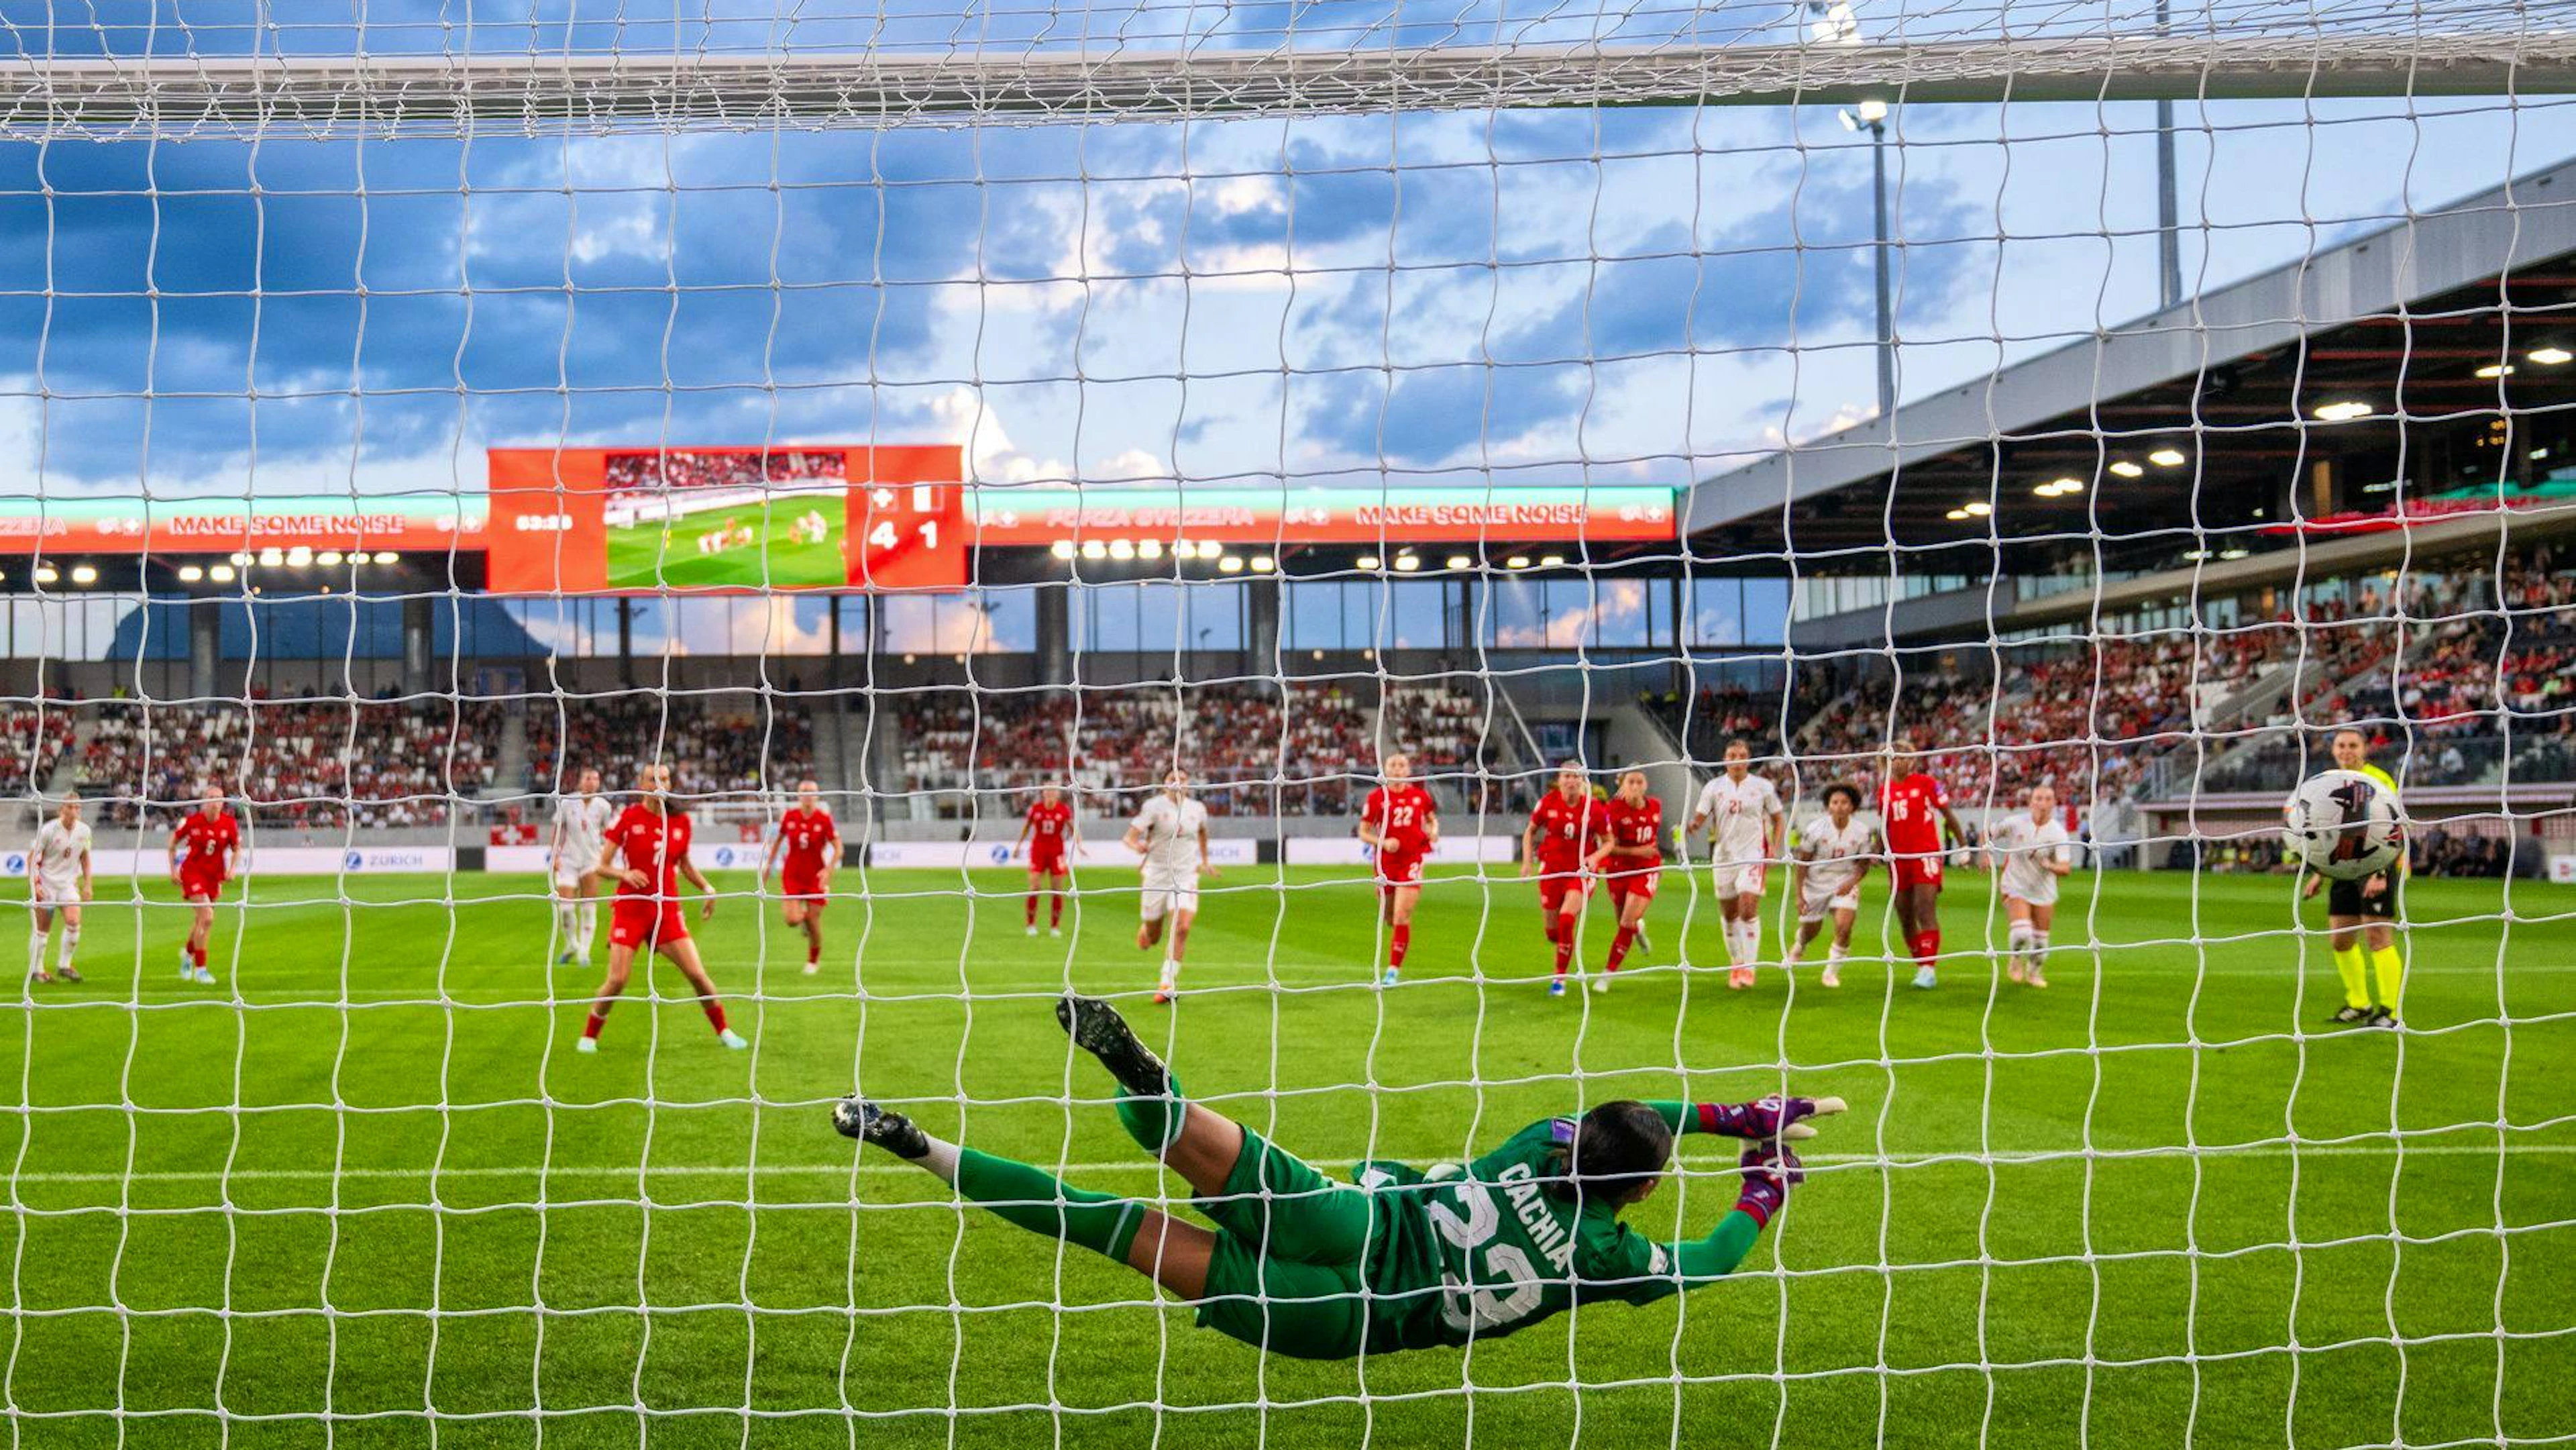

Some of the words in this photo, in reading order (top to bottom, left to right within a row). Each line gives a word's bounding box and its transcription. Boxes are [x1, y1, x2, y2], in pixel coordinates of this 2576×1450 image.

[169, 515, 244, 536] MAKE
[250, 515, 326, 535] SOME
[328, 514, 405, 535] NOISE
[1356, 505, 1430, 526] MAKE
[1431, 505, 1508, 525] SOME
[1511, 504, 1589, 525] NOISE
[869, 521, 898, 550] 4
[918, 520, 937, 549] 1
[1392, 807, 1414, 827] 22
[1564, 821, 1576, 839] 9
[369, 853, 423, 866] ZURICH
[1498, 1161, 1578, 1274] CACHIA
